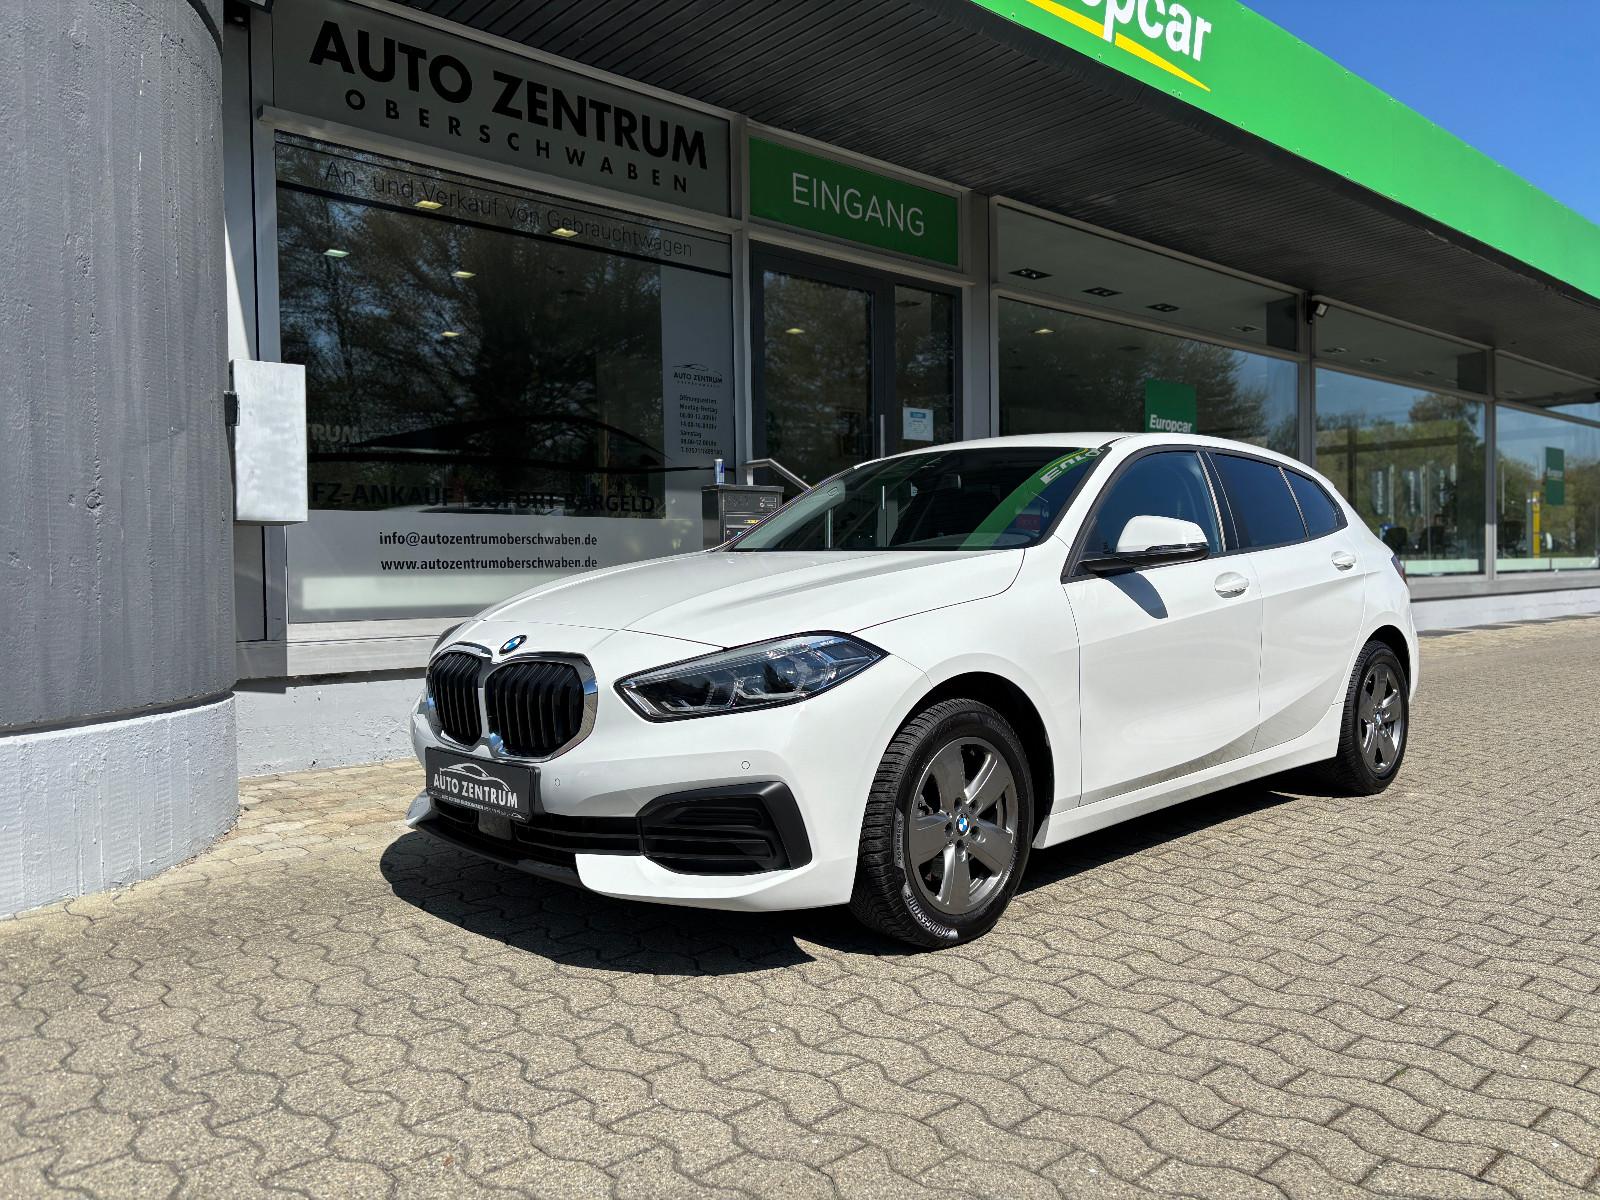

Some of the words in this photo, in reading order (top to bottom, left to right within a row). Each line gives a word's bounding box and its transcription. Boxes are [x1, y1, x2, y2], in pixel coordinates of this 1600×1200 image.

[1081, 0, 1212, 62] pcar
[309, 20, 472, 103] AUTO
[492, 70, 708, 170] ZENTRUM
[345, 88, 688, 194] OBERSCHWABEN
[373, 172, 414, 200] und
[421, 181, 499, 217] Verkauf
[505, 205, 541, 226] von
[547, 210, 692, 258] Gebrauchtwagen
[792, 172, 925, 237] EINGANG
[673, 371, 692, 381] AUTO
[693, 374, 723, 384] ZENTRUM
[1149, 414, 1192, 433] Europcar
[379, 531, 598, 547] info@autozentrumoberschwaben.de
[381, 557, 598, 571] www.autozentrumoberschwaben.de
[433, 773, 459, 794] AUTO
[461, 781, 518, 809] ZENTRUM
